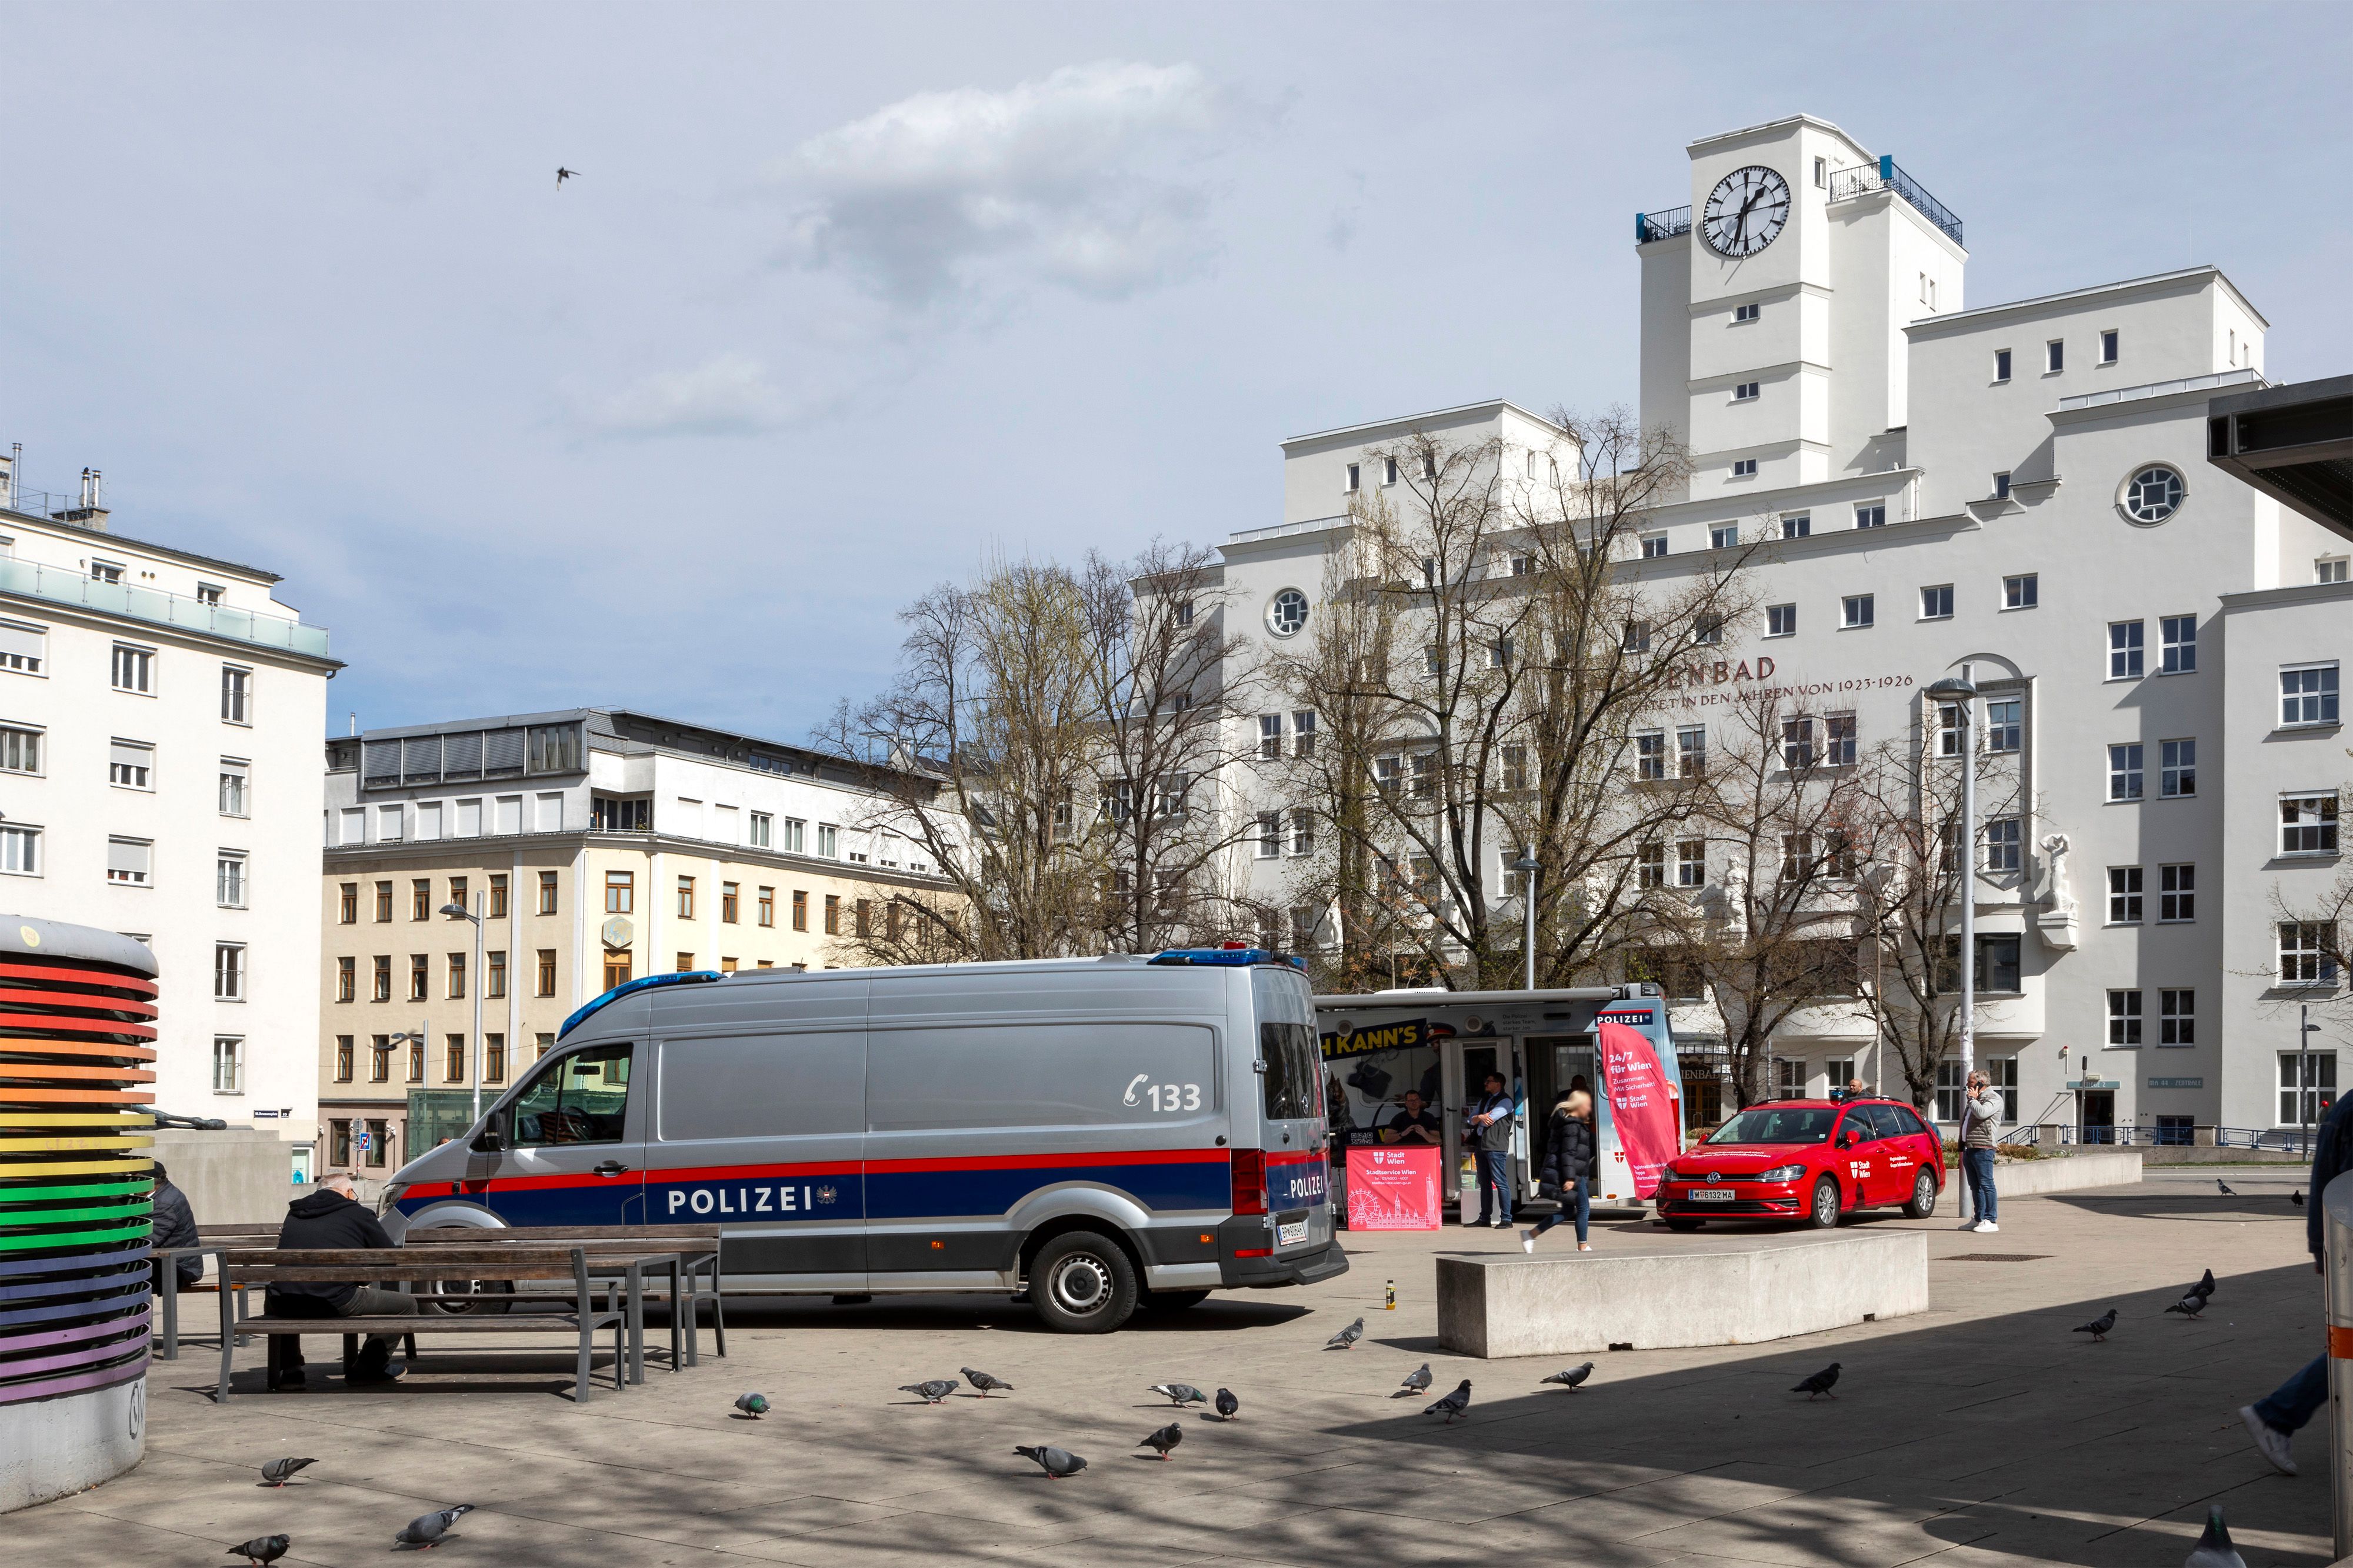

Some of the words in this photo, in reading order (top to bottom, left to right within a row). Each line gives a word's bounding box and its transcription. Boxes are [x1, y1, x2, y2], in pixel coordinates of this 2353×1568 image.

[1701, 692, 1730, 705] DEN
[1735, 686, 1794, 702] JAHREN
[1797, 682, 1834, 695] VON
[1839, 674, 1914, 692] 1923-1926
[1597, 1015, 1643, 1023] POLIZEI
[1337, 1026, 1417, 1054] KANN'S
[1609, 1052, 1633, 1063] 24/7
[1611, 1065, 1625, 1074] für
[1627, 1062, 1652, 1072] Wien
[1613, 1076, 1646, 1085] Zusammen.
[1625, 1082, 1655, 1091] Sicherheit!
[1148, 1084, 1201, 1112] 133
[1859, 1160, 1870, 1169] Stadt
[1859, 1170, 1871, 1178] Wien
[1291, 1176, 1324, 1198] POLIZEI
[668, 1186, 811, 1215] POLIZEI
